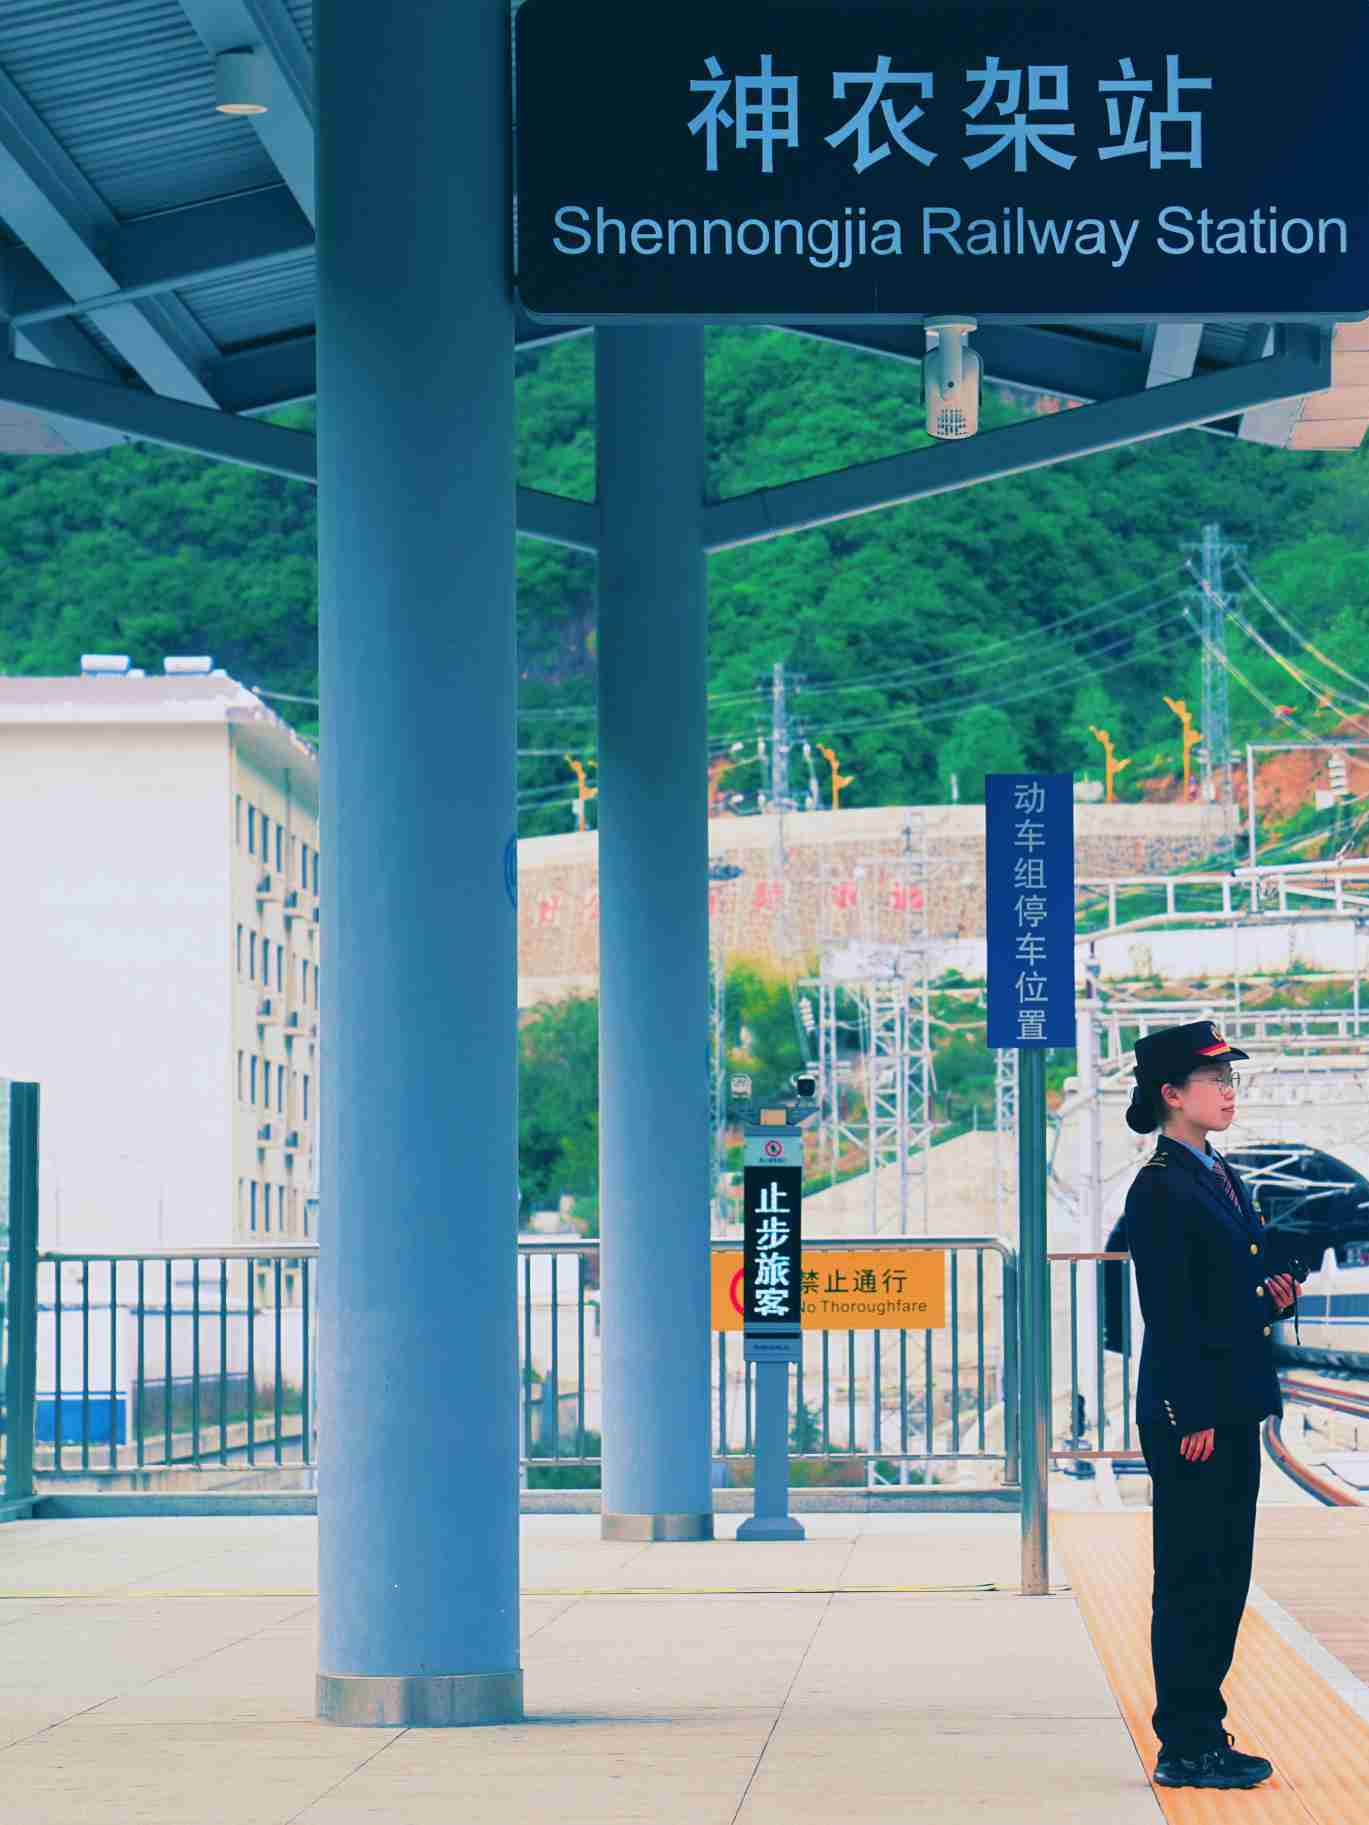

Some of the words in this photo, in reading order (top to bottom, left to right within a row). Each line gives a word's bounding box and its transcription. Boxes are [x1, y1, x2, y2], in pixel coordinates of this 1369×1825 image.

[688, 54, 1213, 172] 神农架站
[553, 205, 902, 269] Shennongjia
[922, 206, 1139, 268] Railway
[1156, 204, 1347, 255] Station
[1014, 781, 1048, 1040] 动车组停车位置
[754, 1182, 791, 1316] 止步旅客
[820, 1300, 928, 1316] Thoroughfare
